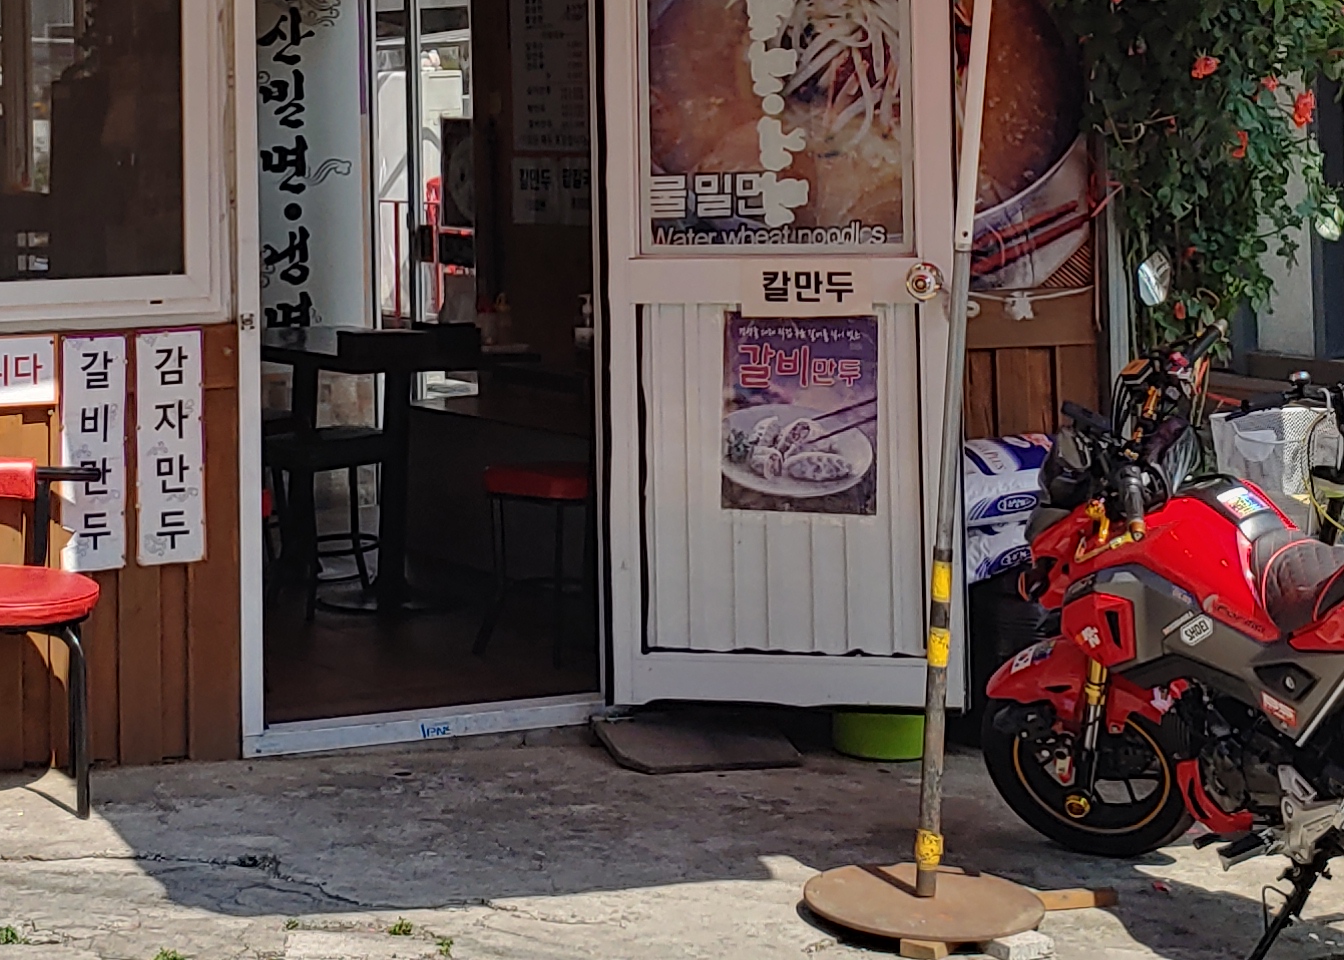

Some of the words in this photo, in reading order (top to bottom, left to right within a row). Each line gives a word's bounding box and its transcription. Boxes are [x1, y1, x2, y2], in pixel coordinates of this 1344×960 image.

[721, 223, 790, 245] wheat
[761, 270, 854, 303] 칼만두
[79, 350, 114, 553] 갈비만두
[154, 345, 192, 551] 감자만두
